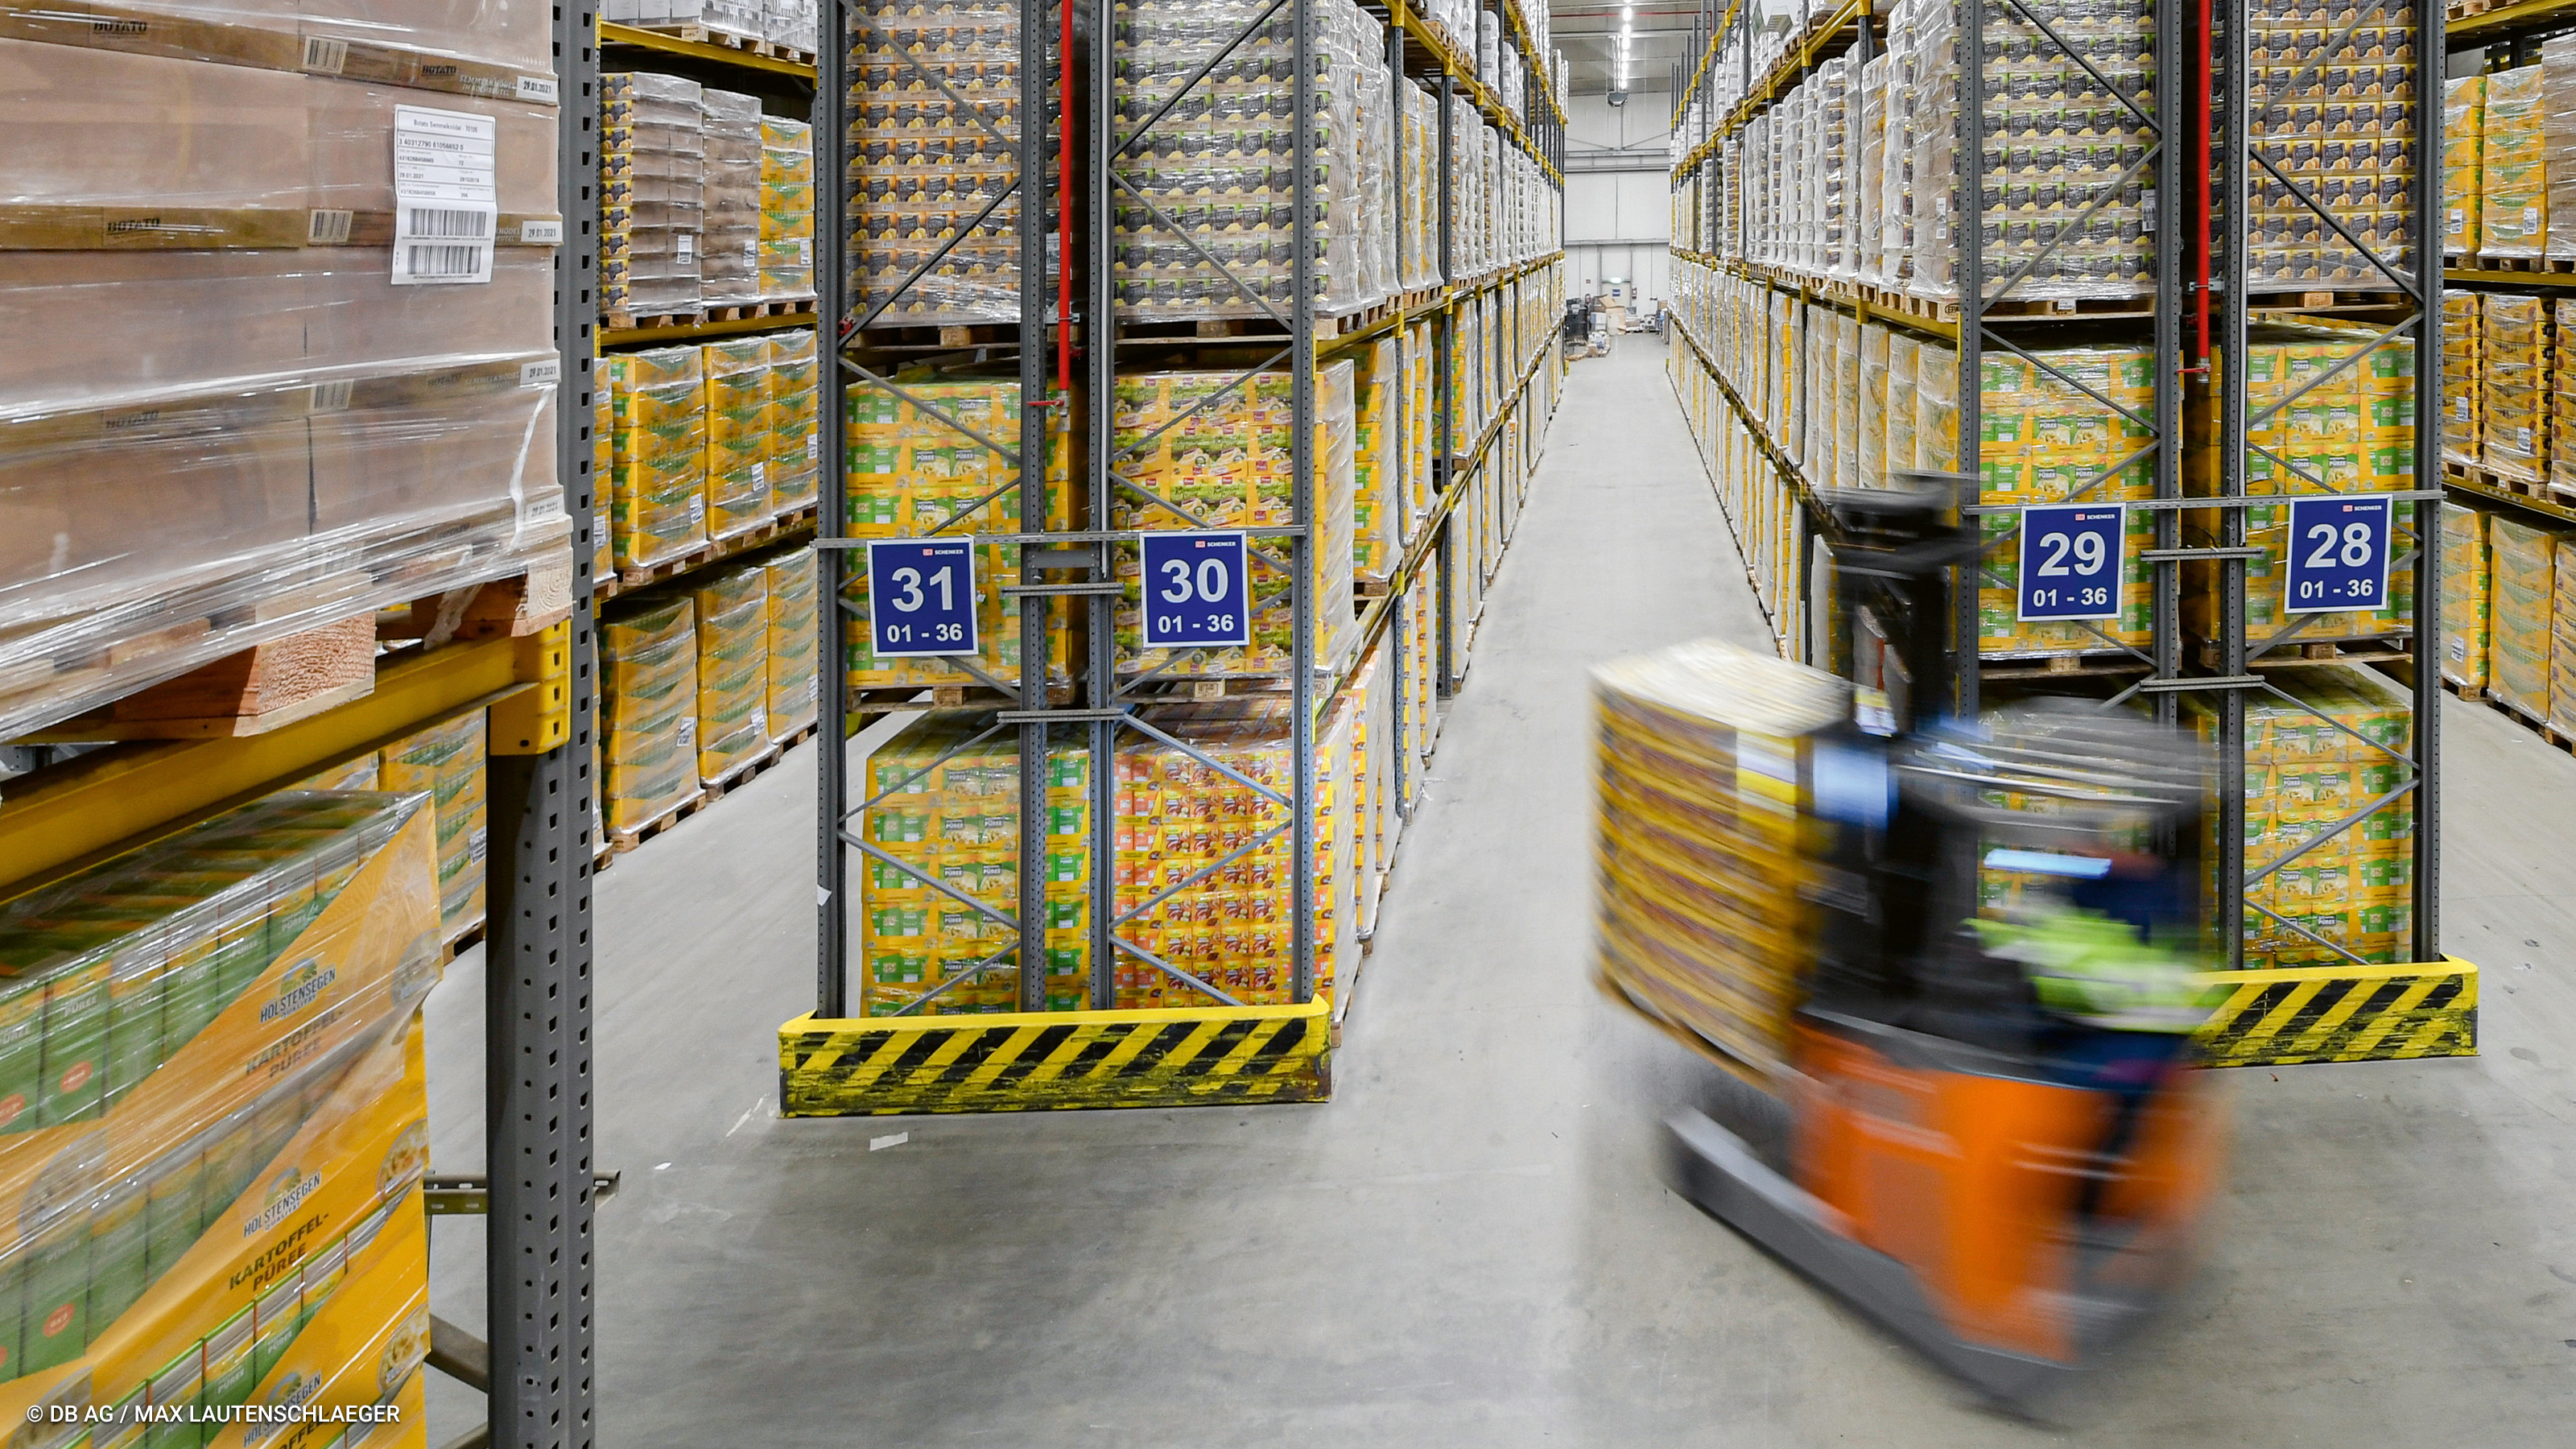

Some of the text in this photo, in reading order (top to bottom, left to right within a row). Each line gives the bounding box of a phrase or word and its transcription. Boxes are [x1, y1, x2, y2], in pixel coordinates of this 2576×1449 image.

[423, 65, 456, 75] BOTATO
[523, 80, 551, 94] 29.01.2021
[404, 139, 431, 147] 40312790
[528, 228, 556, 238] 29.01.2021
[2037, 530, 2106, 577] 29
[2304, 522, 2372, 568] 28
[891, 566, 953, 612] 31
[1161, 558, 1228, 603] 30
[2300, 580, 2323, 599] 01
[2347, 579, 2373, 597] 36
[2033, 588, 2057, 607] 01
[2081, 587, 2107, 605] 36
[887, 624, 911, 642] 01
[935, 623, 963, 642] 36
[1158, 615, 1183, 634] 01
[1207, 614, 1234, 632] 36
[260, 967, 336, 1023] HOLSTENSEGEN
[243, 1172, 321, 1238] HOLSTENSEGEN
[229, 1213, 329, 1290] KARTOFFEL-
[253, 1242, 307, 1291] PÜREE
